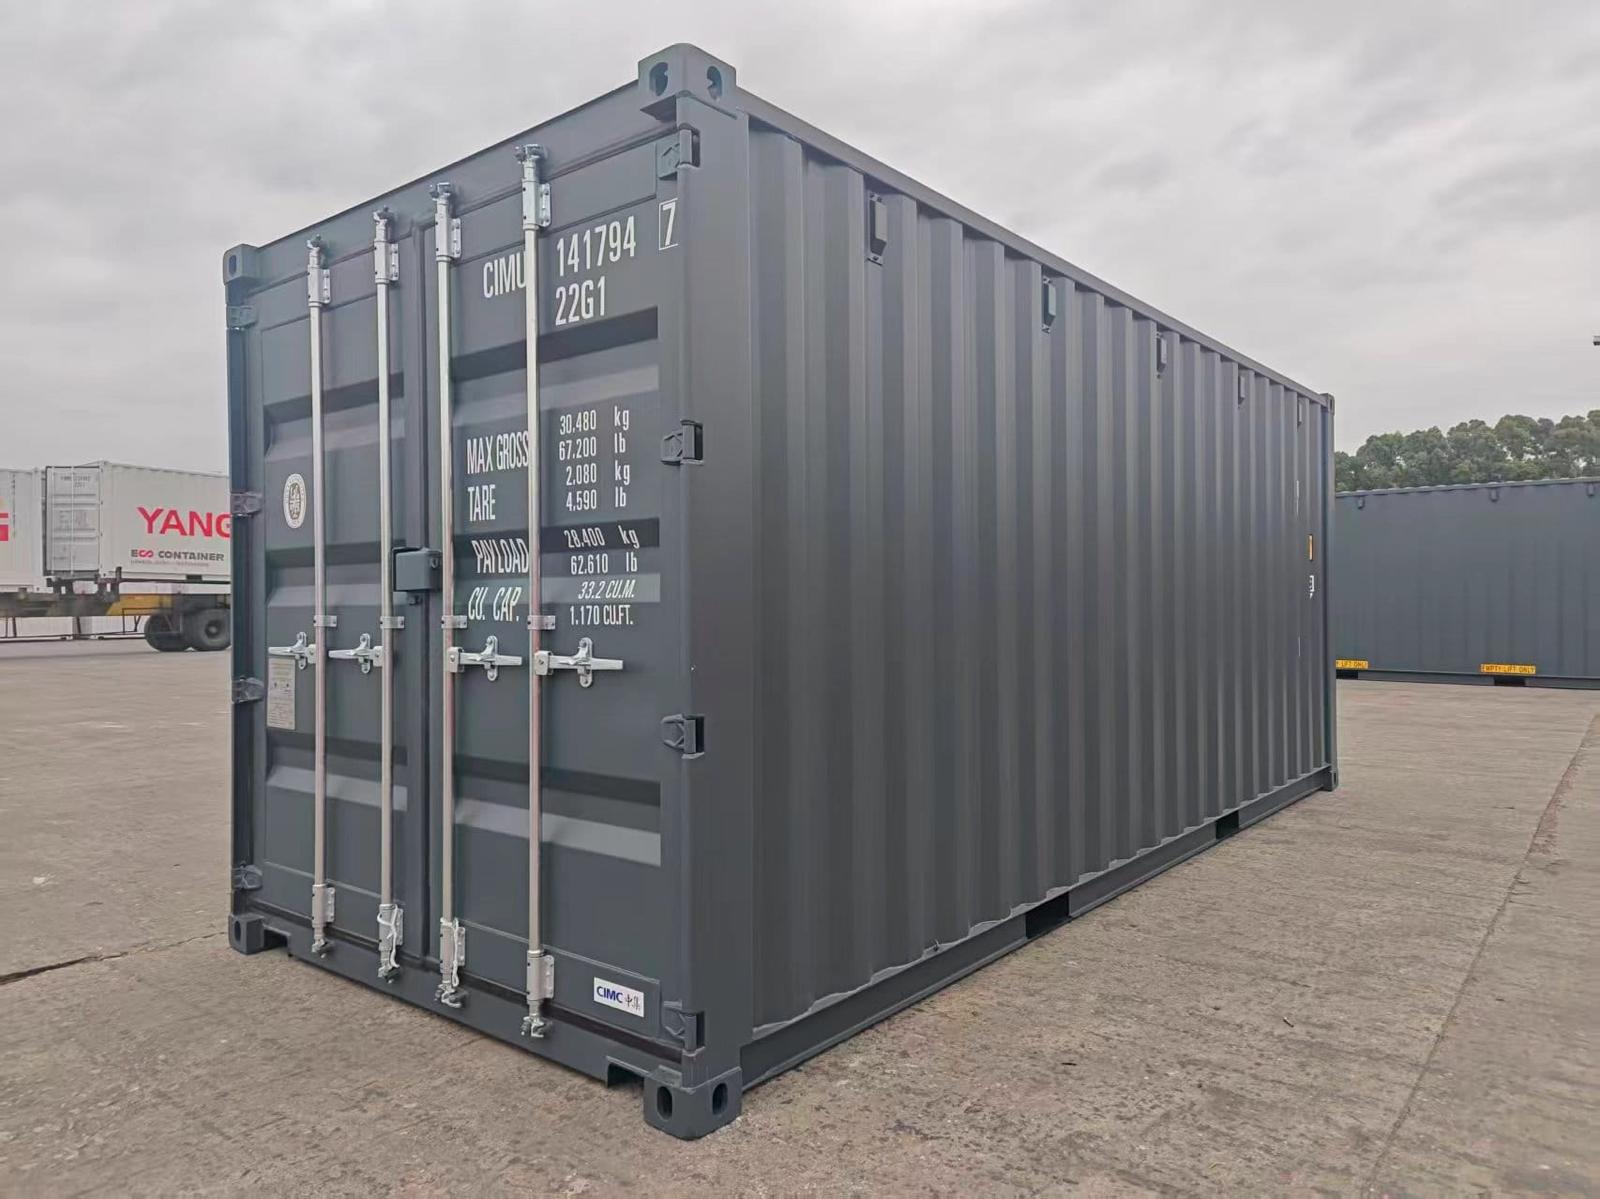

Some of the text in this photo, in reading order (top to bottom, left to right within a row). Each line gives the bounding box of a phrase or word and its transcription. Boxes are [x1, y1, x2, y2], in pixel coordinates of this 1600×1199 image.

[483, 201, 676, 298] CIMU 141794 7
[555, 276, 606, 326] 22G1
[560, 406, 630, 436] 30.480 kg
[467, 430, 528, 475] MAX GROSS
[559, 433, 626, 461] 67.200 lb
[566, 460, 631, 486] 2.080 kg
[468, 484, 496, 522] TARE
[566, 486, 627, 511] 4.590 lb
[137, 507, 230, 538] YANG
[564, 525, 640, 549] 28.400 kg
[158, 550, 225, 562] CONTAINER
[471, 538, 529, 574] PAYLOAD
[570, 552, 638, 575] 62.610 lb
[468, 587, 522, 622] CU. CAP.
[578, 581, 605, 600] 33.2
[570, 604, 600, 625] 1.170
[596, 985, 624, 1004] CIMC
